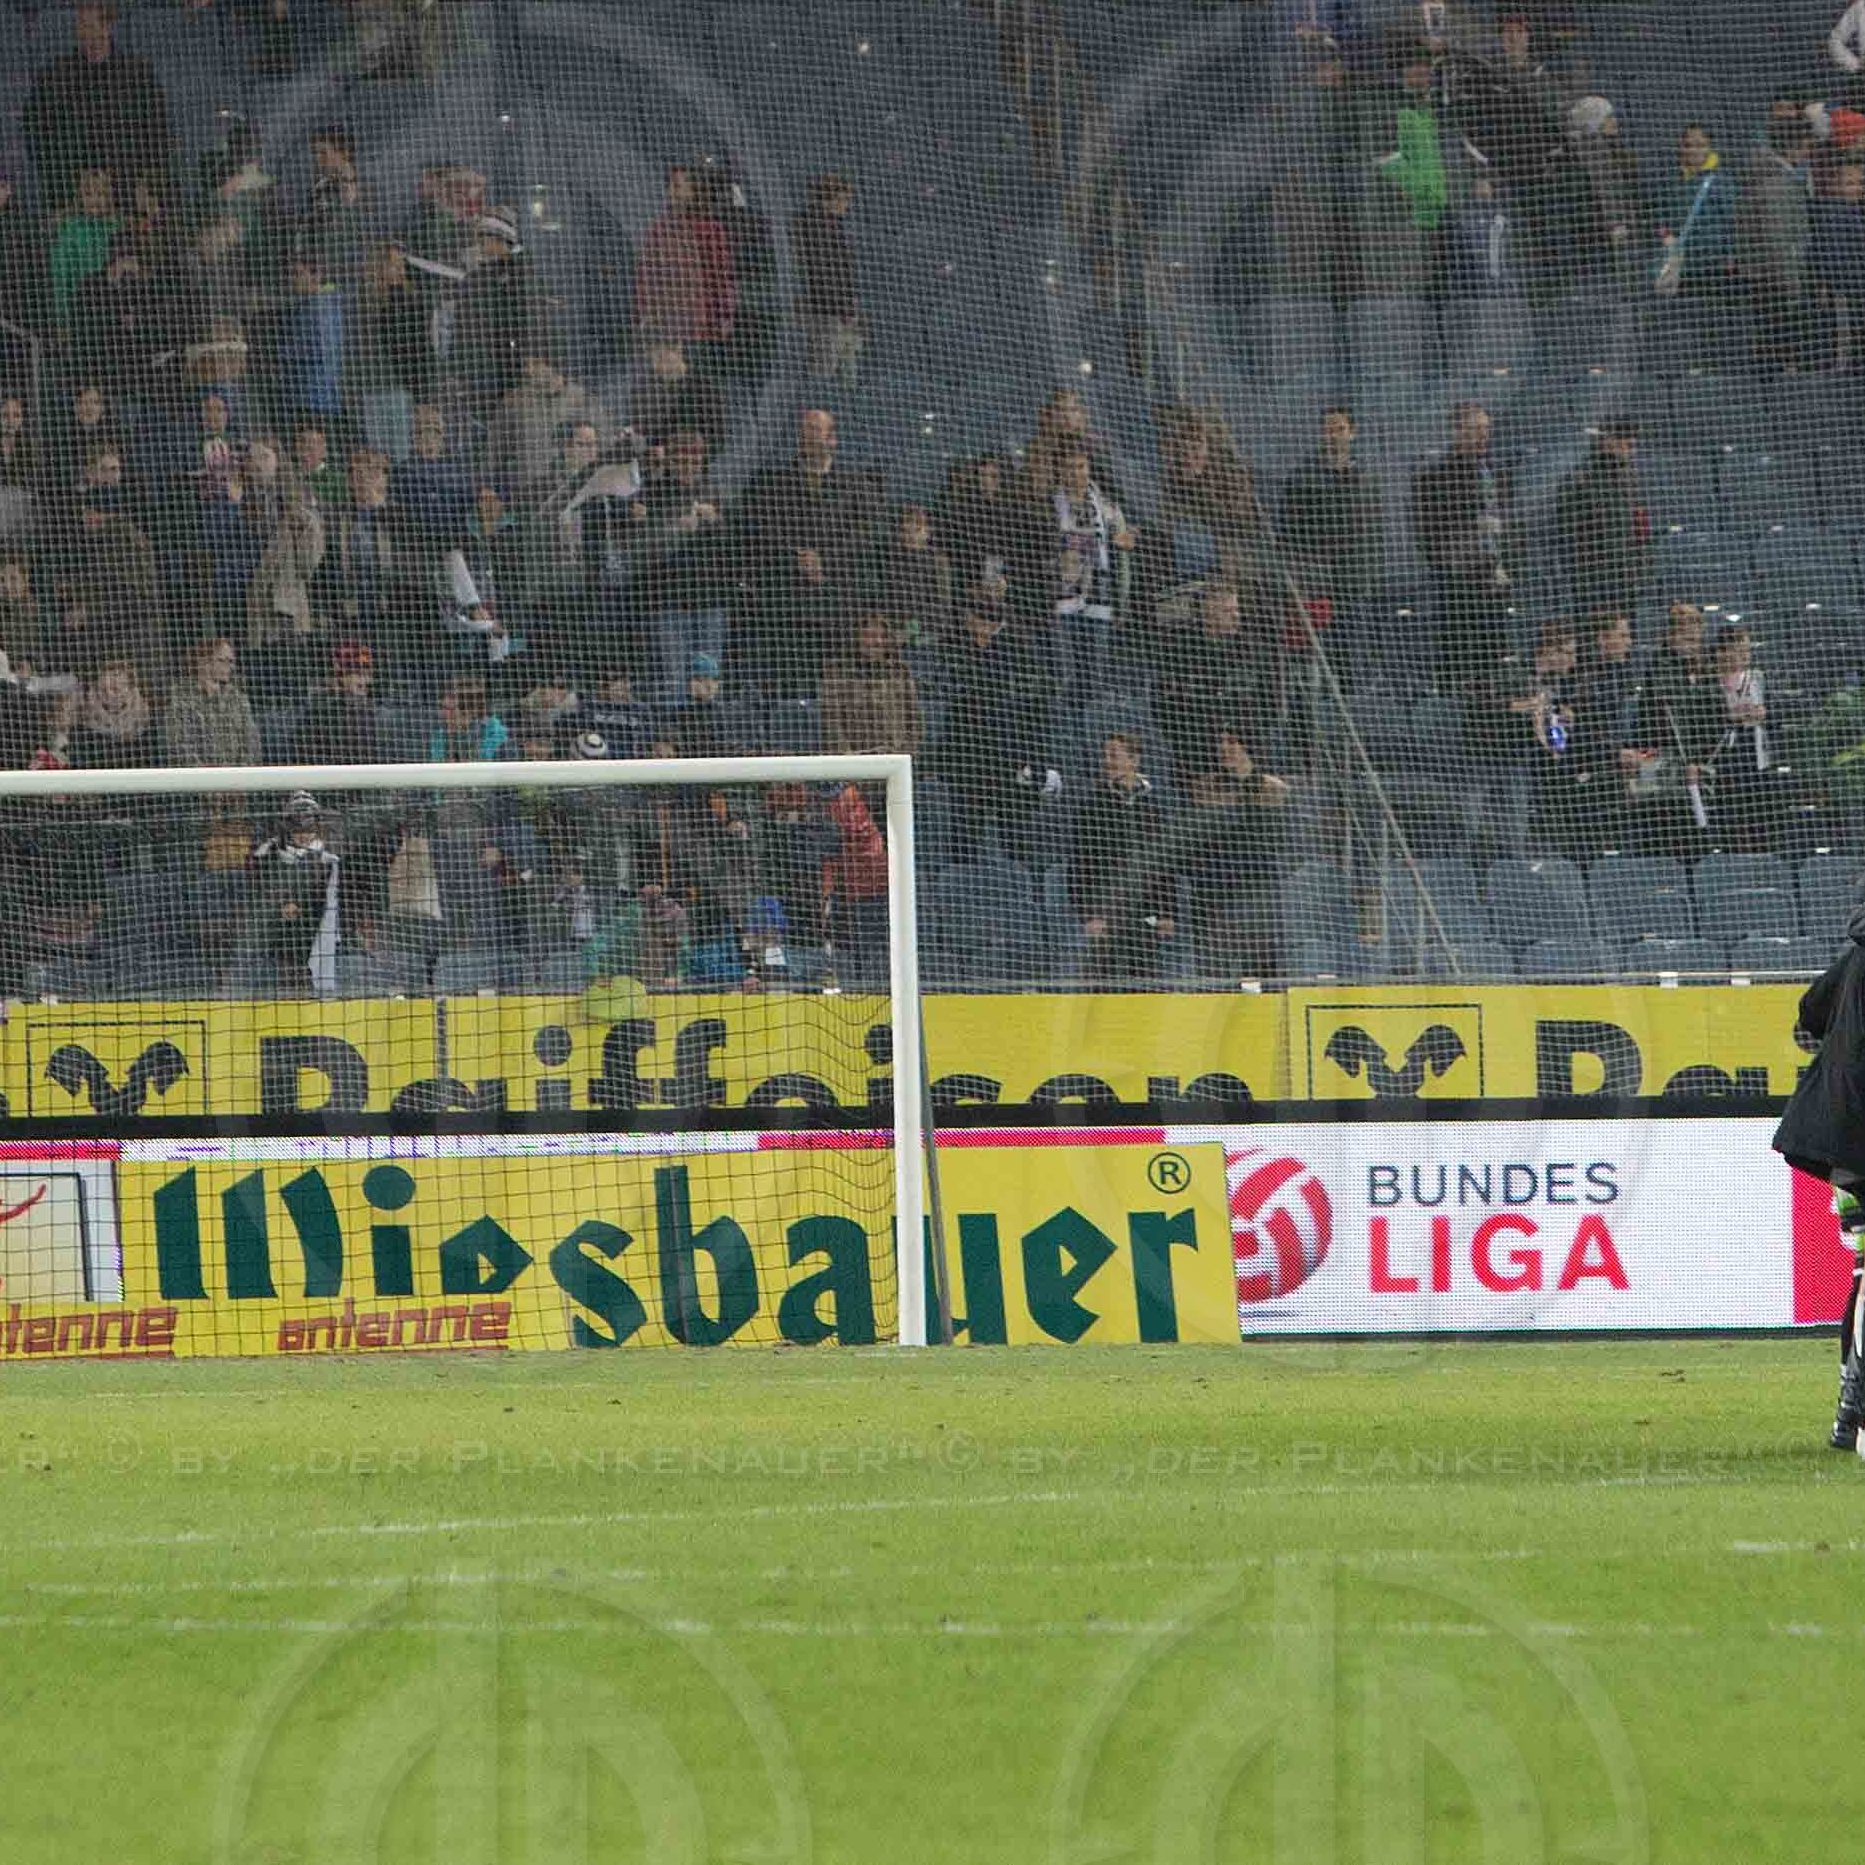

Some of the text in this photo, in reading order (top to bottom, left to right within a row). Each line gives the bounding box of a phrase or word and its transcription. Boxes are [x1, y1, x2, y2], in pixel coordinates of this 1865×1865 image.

[1367, 1162, 1620, 1207] BUNDES
[1368, 1213, 1632, 1294] LIGA
[278, 1297, 511, 1351] antenne
